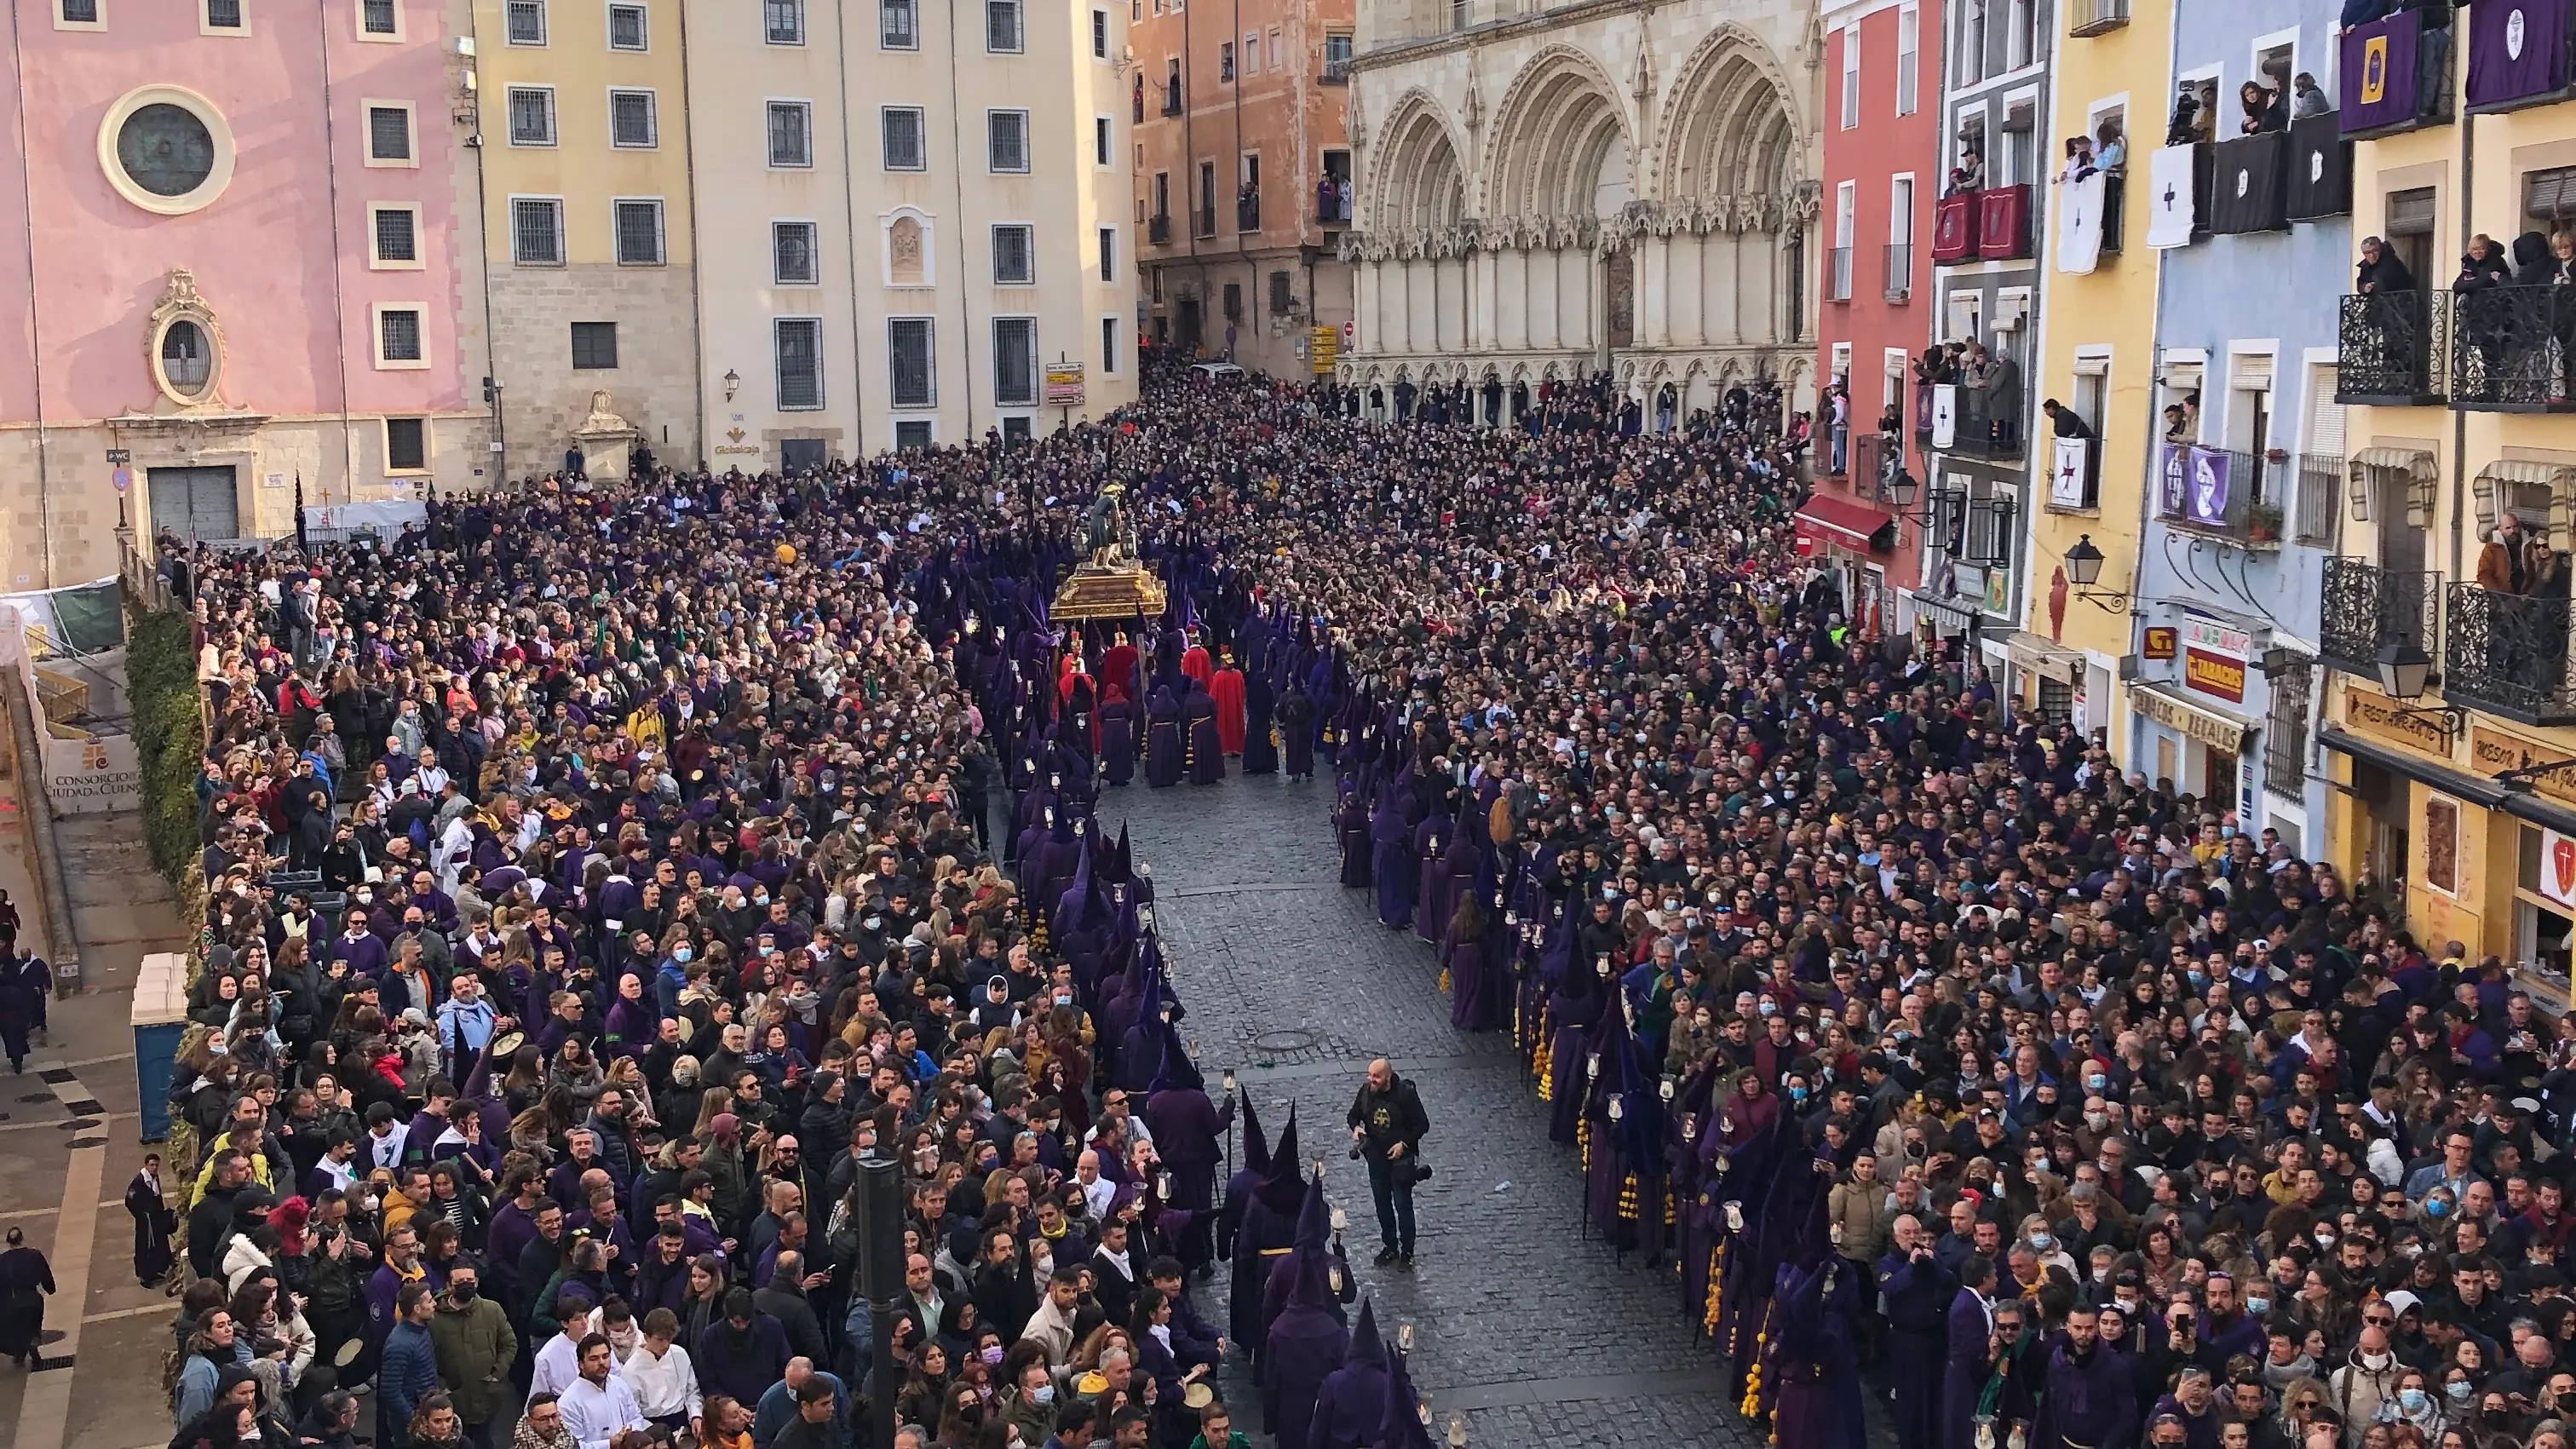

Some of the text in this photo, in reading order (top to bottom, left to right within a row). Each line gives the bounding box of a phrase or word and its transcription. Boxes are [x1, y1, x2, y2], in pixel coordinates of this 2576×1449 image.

[714, 445, 760, 457] Globalcaja
[2197, 658, 2243, 687] TABACOS
[55, 772, 129, 785] CONSORCIO
